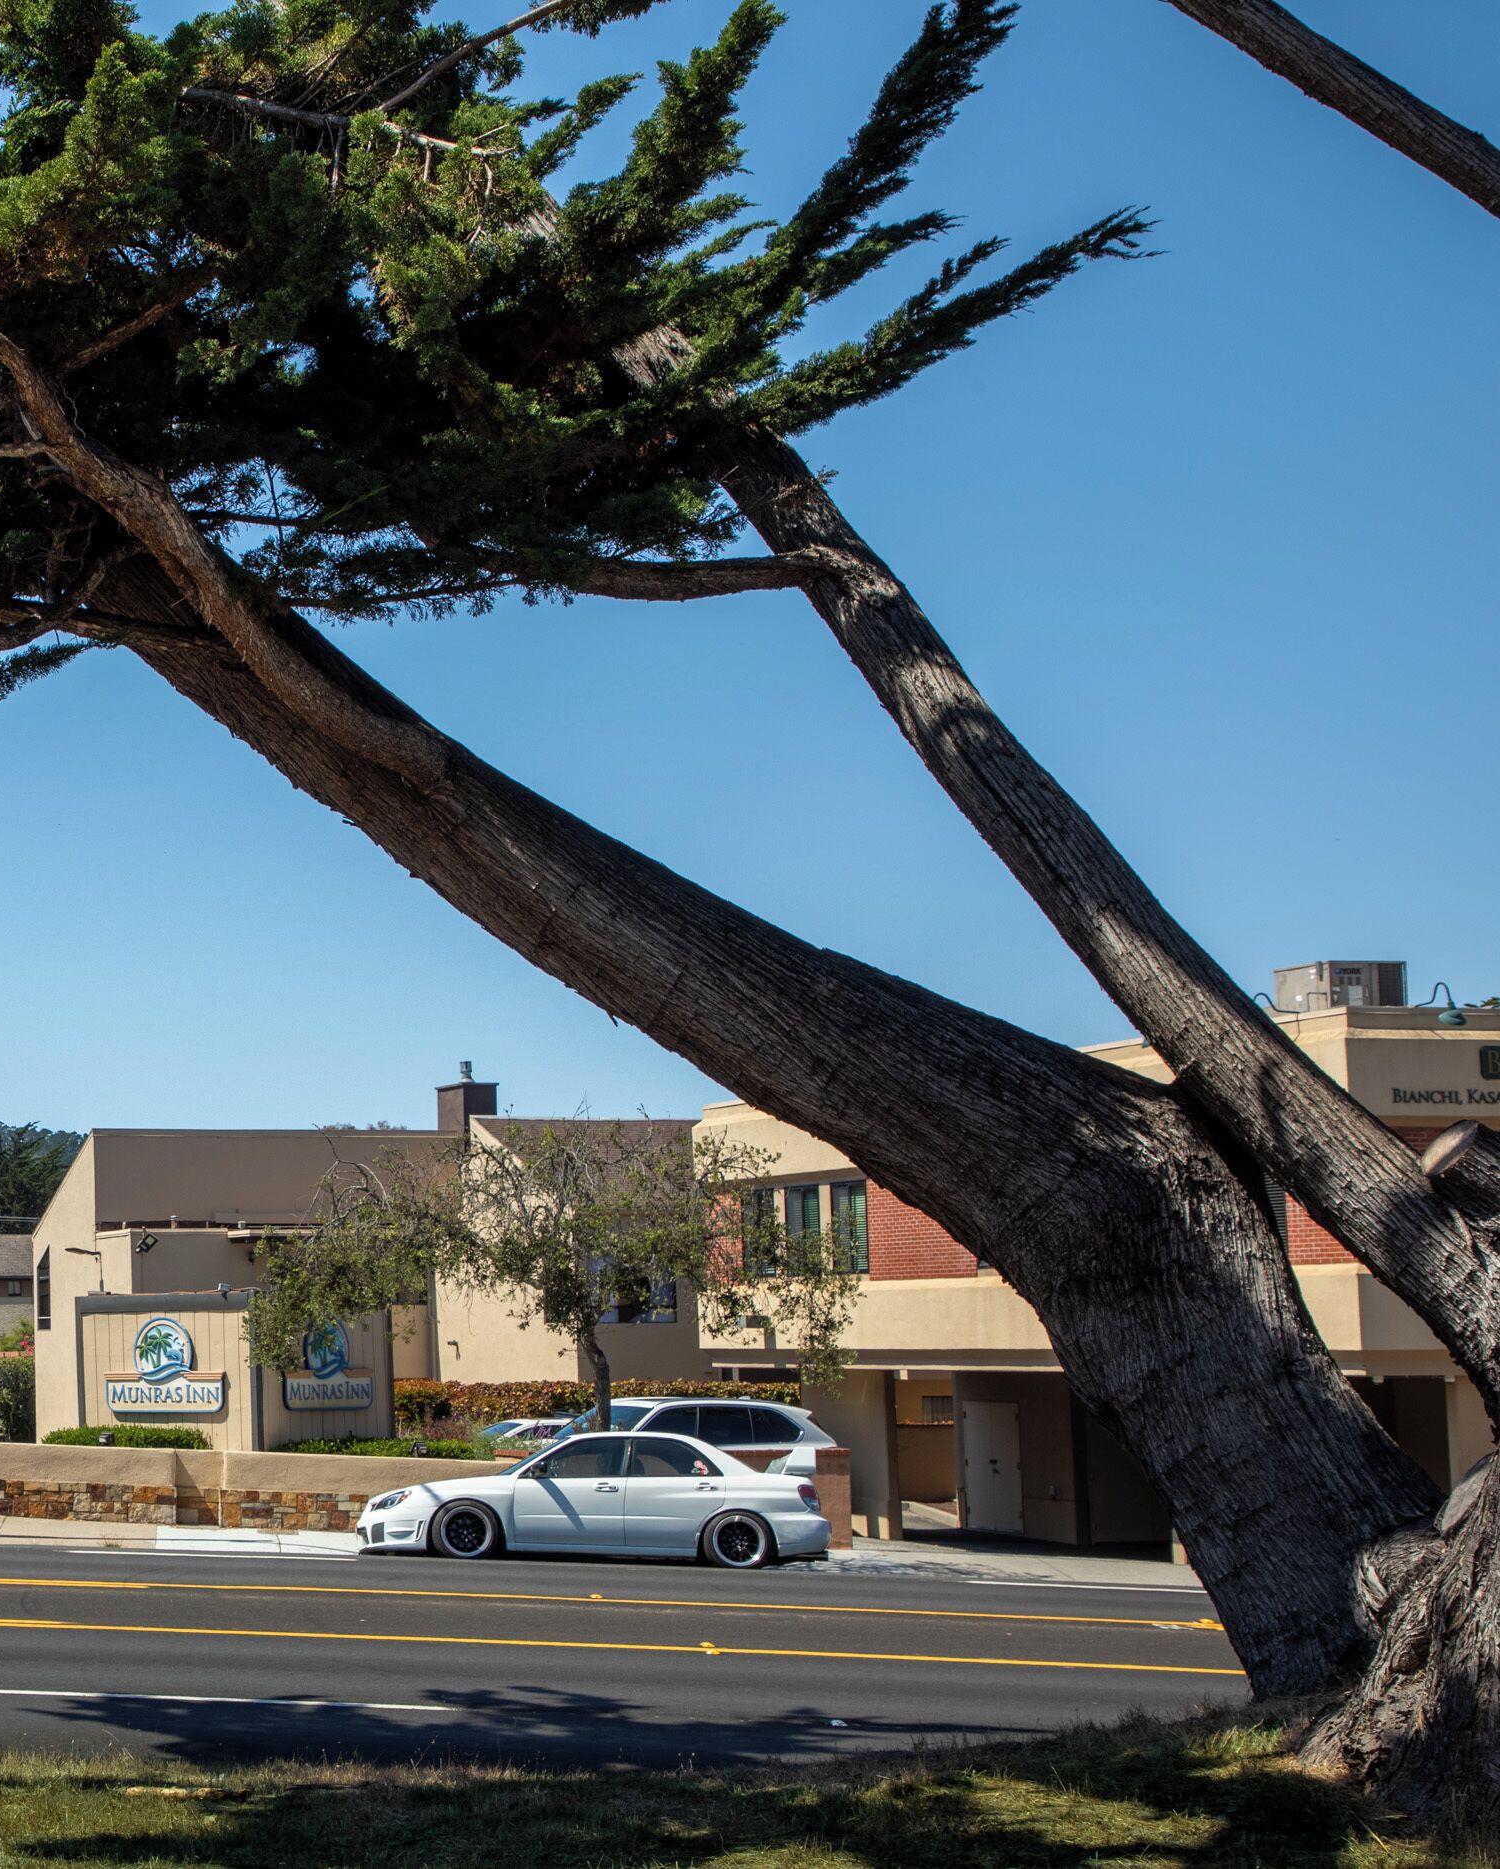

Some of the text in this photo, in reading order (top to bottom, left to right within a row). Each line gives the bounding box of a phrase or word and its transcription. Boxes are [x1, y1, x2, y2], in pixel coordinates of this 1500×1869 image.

[1391, 1088, 1463, 1105] BIANCHI,
[111, 1384, 219, 1404] MUNRAS INN
[290, 1381, 370, 1401] MUNRAS INN
